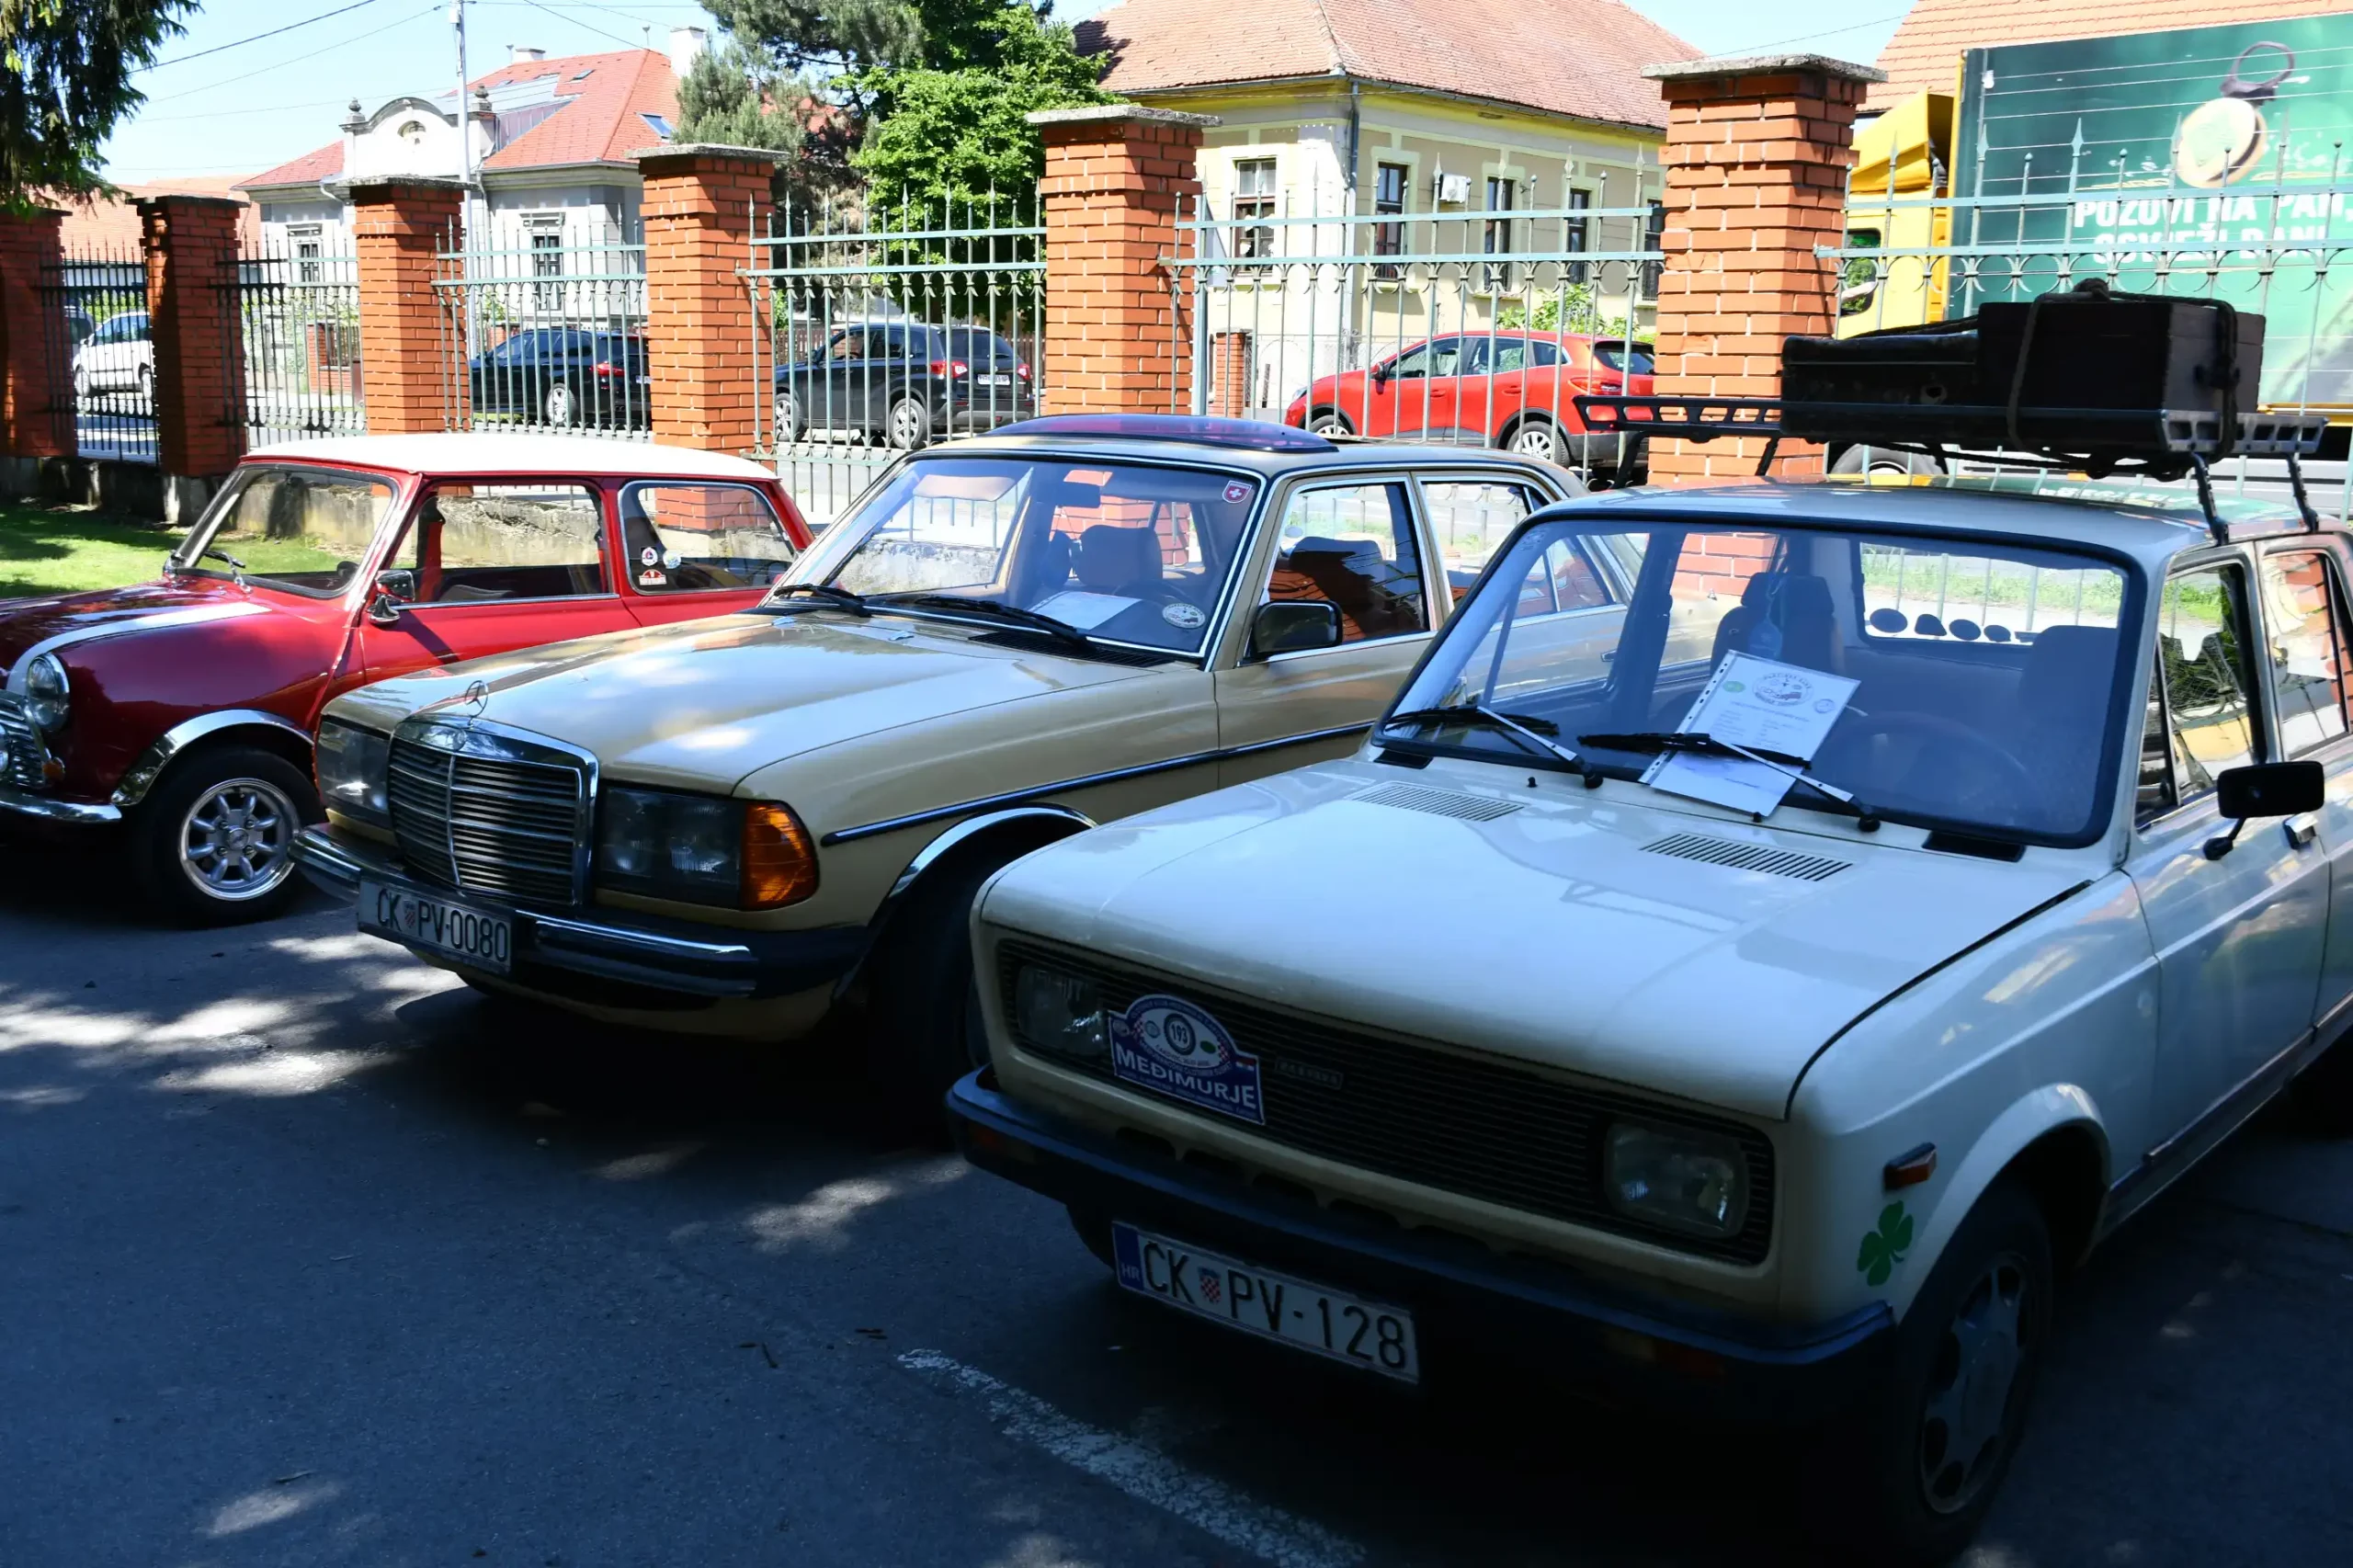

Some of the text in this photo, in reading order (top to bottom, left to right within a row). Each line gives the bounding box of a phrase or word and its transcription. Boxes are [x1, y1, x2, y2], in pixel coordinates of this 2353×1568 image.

[2074, 198, 2195, 228] POZOVI
[2208, 196, 2257, 222] NA
[418, 900, 508, 962] PV-0080
[1171, 1023, 1188, 1045] 193
[1115, 1040, 1257, 1110] MEĐIMURJE
[1120, 1262, 1141, 1281] HR
[1227, 1267, 1406, 1369] PV-128
